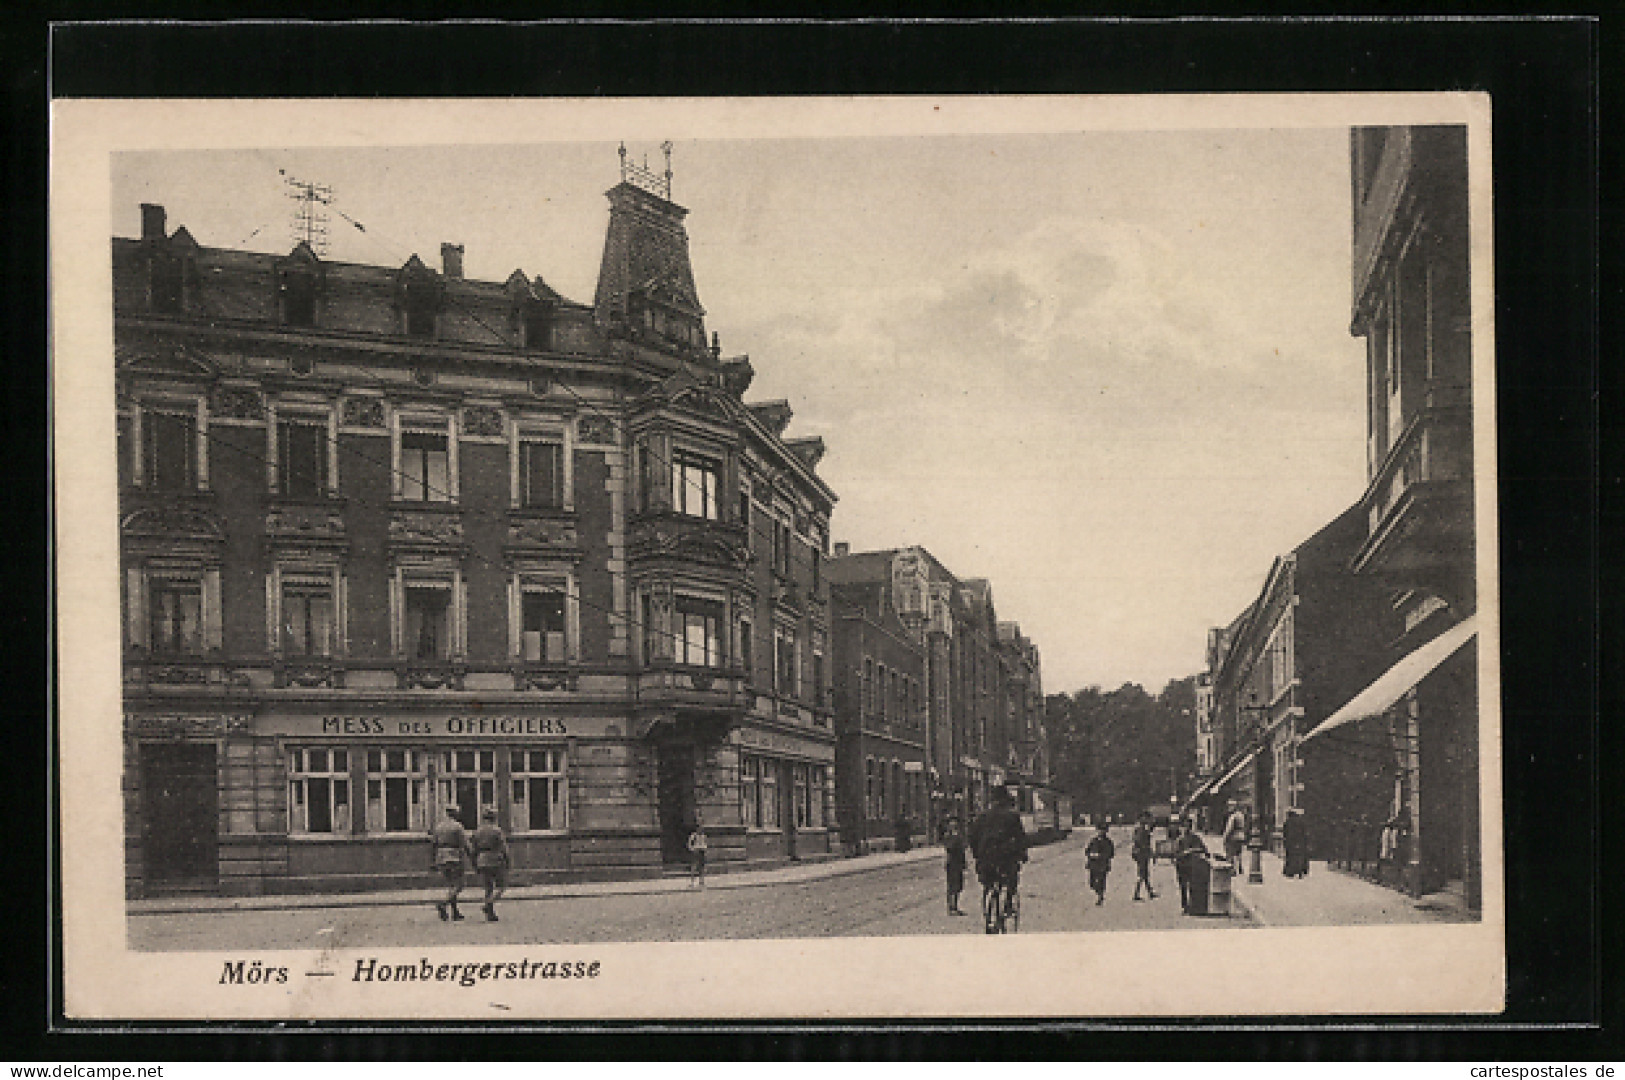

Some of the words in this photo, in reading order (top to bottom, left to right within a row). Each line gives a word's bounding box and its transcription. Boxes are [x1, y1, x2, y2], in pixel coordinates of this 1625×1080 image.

[322, 716, 384, 734] MESS
[398, 721, 431, 734] DES
[446, 716, 567, 734] OFFICIERS
